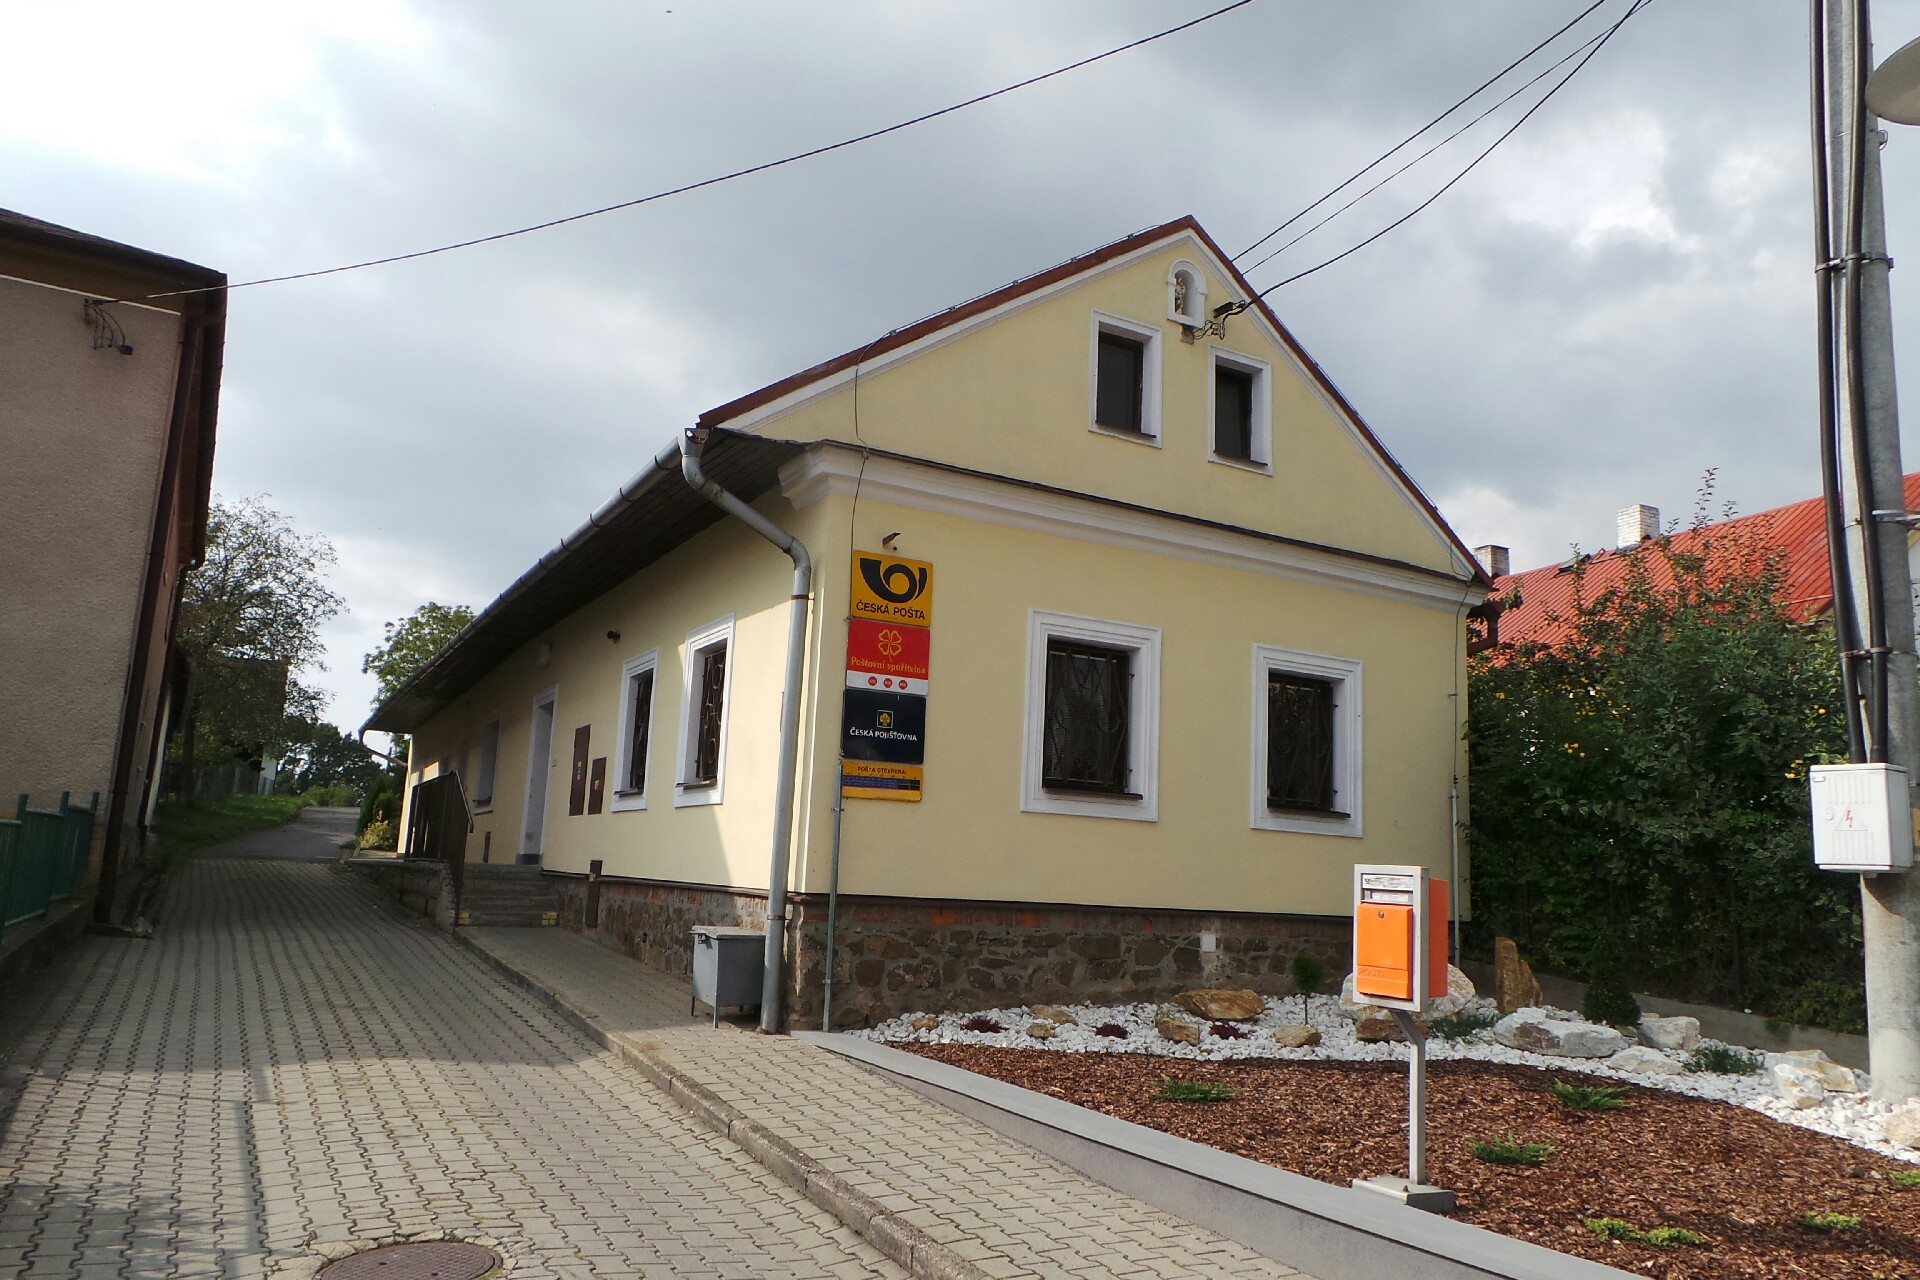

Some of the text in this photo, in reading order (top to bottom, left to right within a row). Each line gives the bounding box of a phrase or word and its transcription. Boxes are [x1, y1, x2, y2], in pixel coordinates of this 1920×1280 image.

[856, 599, 925, 620] ČESKÁ POŠTA
[851, 657, 925, 674] Poštovní spořitelna
[850, 727, 873, 737] ČESKÁ
